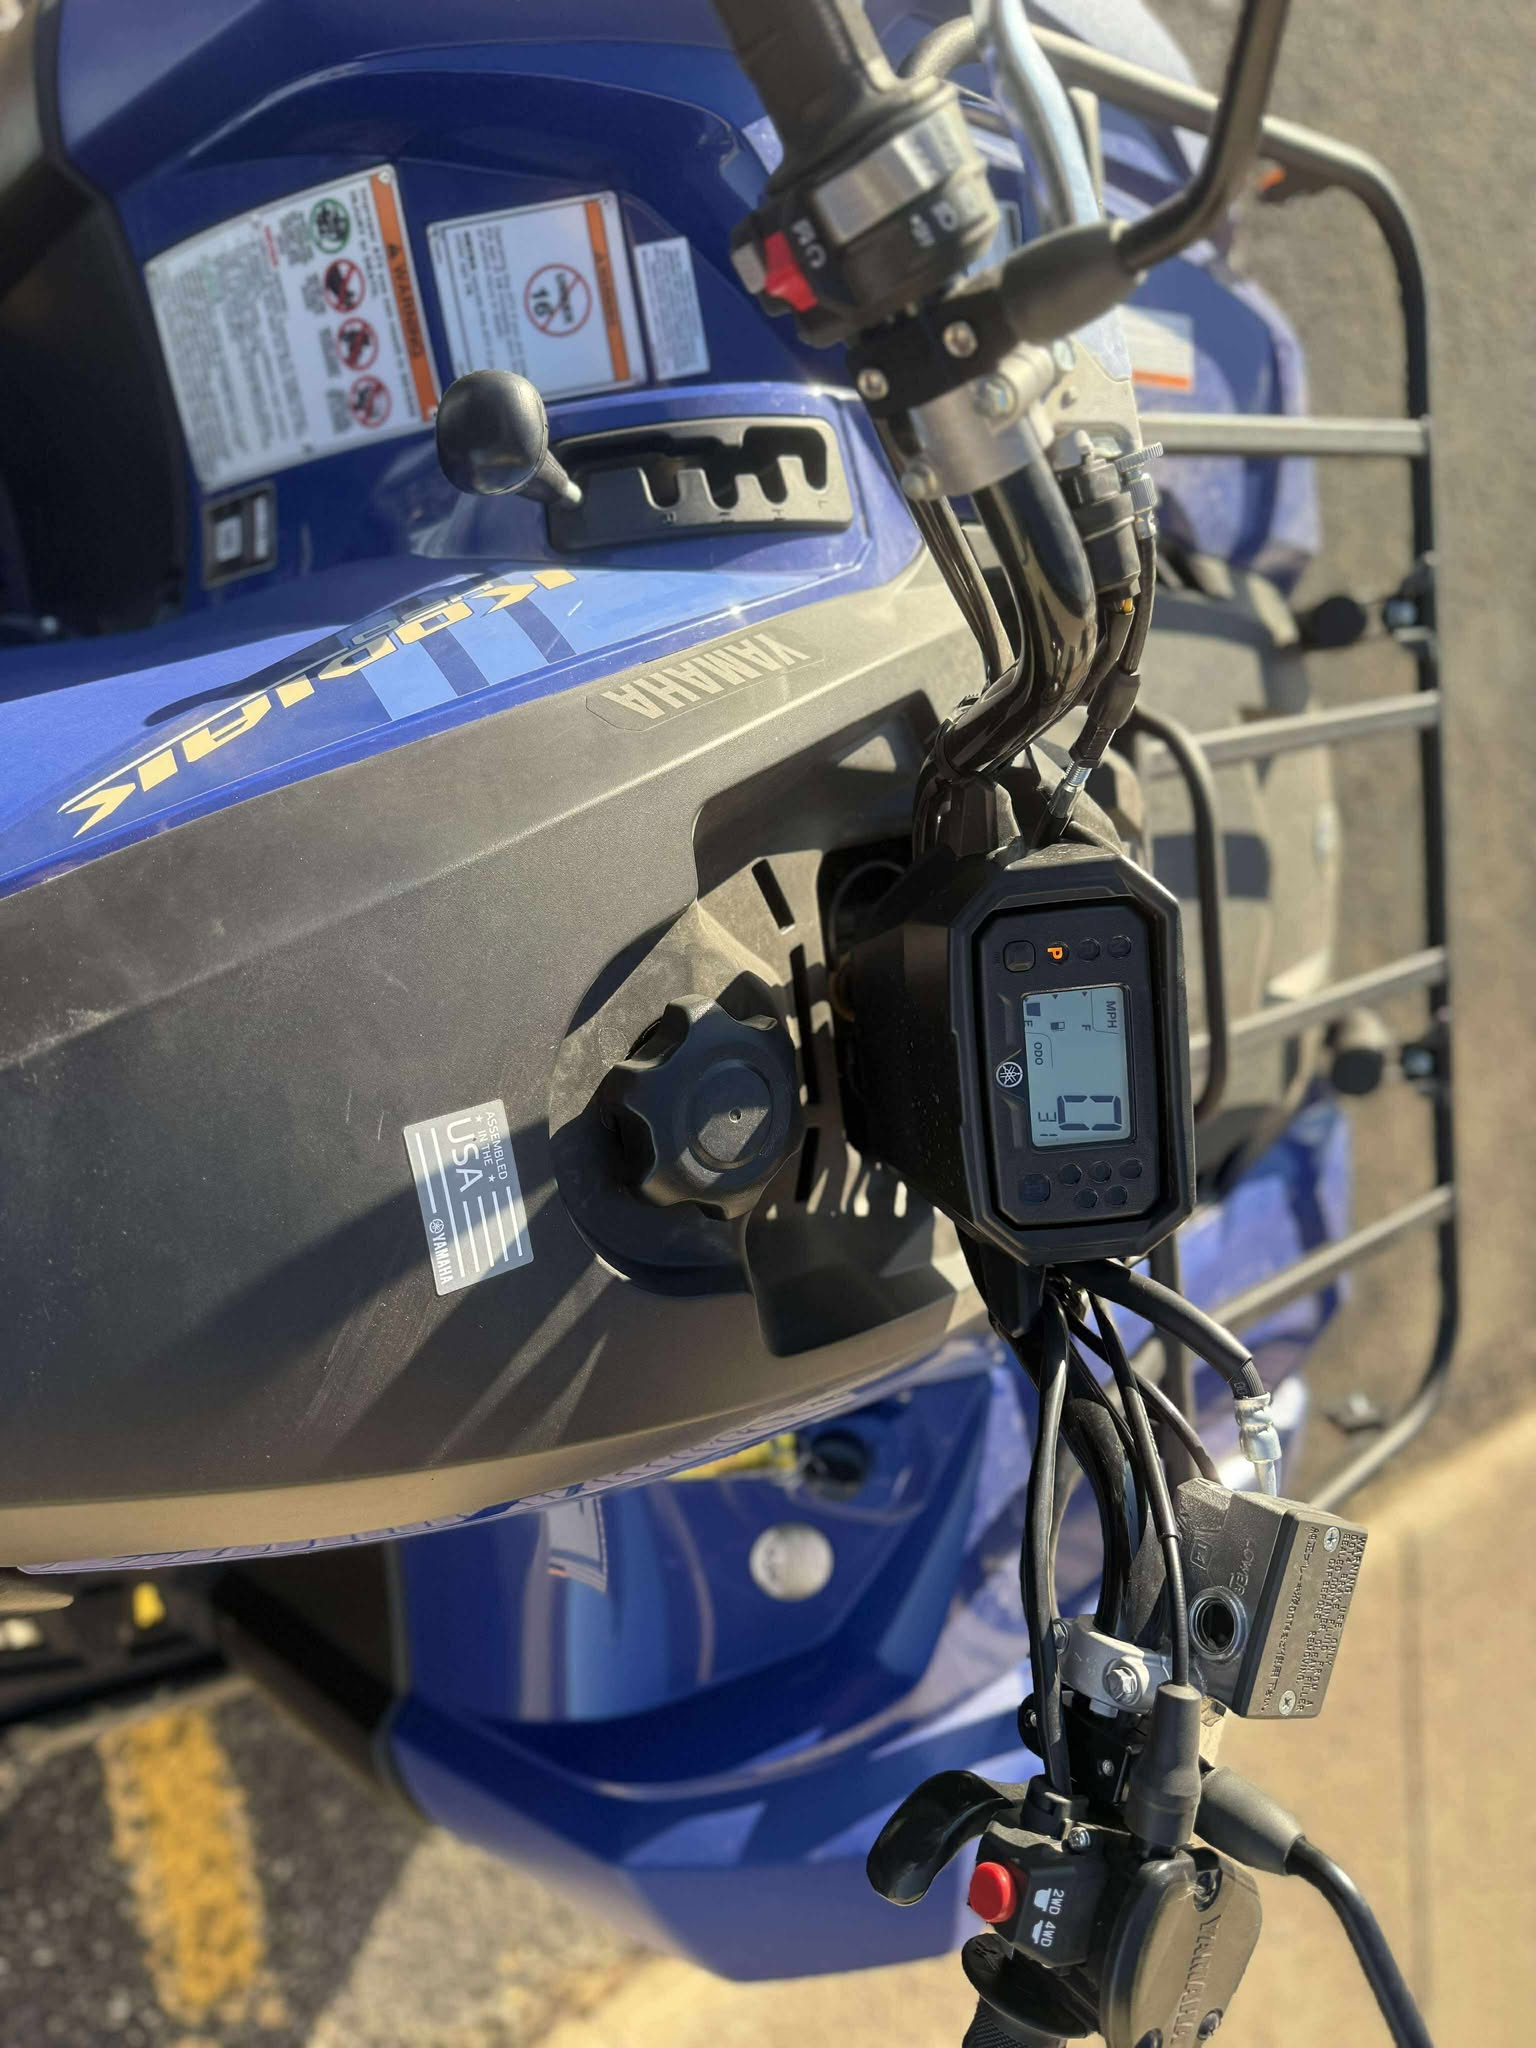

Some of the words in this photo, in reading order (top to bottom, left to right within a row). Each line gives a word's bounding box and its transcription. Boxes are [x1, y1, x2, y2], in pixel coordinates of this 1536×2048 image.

[394, 258, 422, 357] WARNING
[530, 287, 549, 318] 16
[600, 632, 811, 720] YAMAHA
[65, 569, 577, 838] KODIAK
[1047, 947, 1063, 960] P
[1081, 1024, 1092, 1032] F
[1105, 1000, 1118, 1029] MPH
[1033, 1041, 1044, 1066] ODO
[1037, 1111, 1058, 1137] 31
[1056, 1095, 1123, 1131] 0
[477, 1130, 489, 1143] IN
[485, 1111, 508, 1180] ASSEMBLED
[446, 1117, 484, 1193] USA
[480, 1144, 494, 1167] THE
[433, 1232, 454, 1286] YAMAHA
[1334, 1533, 1350, 1573] SEALED
[1343, 1536, 1367, 1595] WARNING
[1346, 1534, 1358, 1564] DOT4
[1325, 1558, 1335, 1579] CAP
[1313, 1580, 1330, 1620] BEFORE
[1332, 1573, 1348, 1610] BRAKE
[1335, 1606, 1347, 1628] USE
[1321, 1619, 1337, 1653] FLUID
[1325, 1637, 1338, 1666] ONLY
[1295, 1630, 1317, 1684] REMOVING.
[1306, 1639, 1322, 1673] CLEAN
[1310, 1660, 1325, 1692] FROM
[1295, 1676, 1312, 1713] FILLER
[1049, 1889, 1065, 1915] 2WD
[1041, 1921, 1057, 1948] 4WD
[1170, 1914, 1222, 2045] YAMAHA
